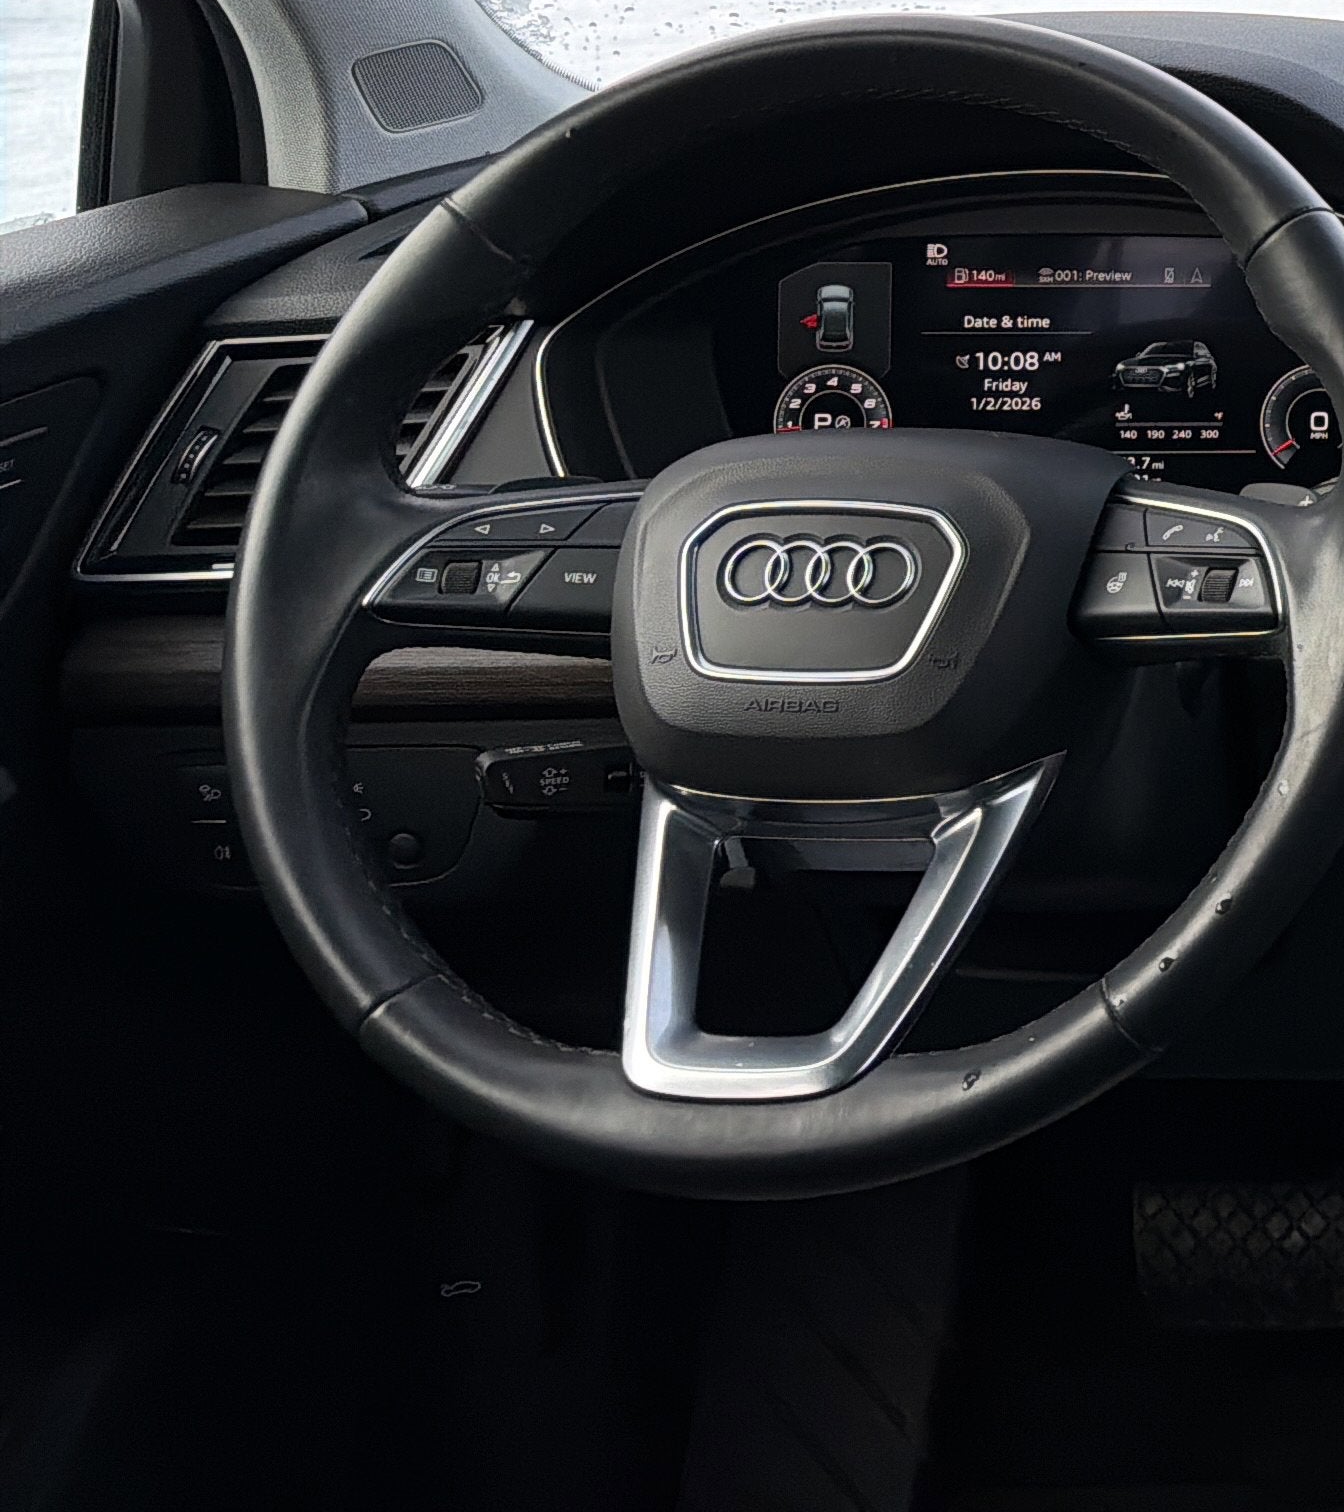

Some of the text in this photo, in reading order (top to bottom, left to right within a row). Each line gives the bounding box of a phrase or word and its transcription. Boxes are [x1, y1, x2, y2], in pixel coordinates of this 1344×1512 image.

[926, 257, 948, 266] AUTO
[1055, 270, 1132, 282] 001: Preview
[964, 315, 1050, 328] Date & time
[975, 351, 1062, 371] 10:08 AM
[826, 376, 839, 387] 4
[983, 378, 1028, 395] Friday
[803, 383, 817, 394] 3
[850, 383, 863, 394] 5
[789, 398, 802, 409] 2
[864, 398, 877, 409] 6
[970, 397, 1042, 411] 1/2/2026
[814, 413, 832, 430] P
[1310, 411, 1329, 431] 0
[1120, 429, 1219, 439] 140 190 240 300
[1152, 460, 1165, 470] mi
[485, 571, 501, 583] OK
[564, 572, 597, 584] VIEW
[743, 697, 840, 714] AIRBAG
[539, 776, 570, 786] SPEED
